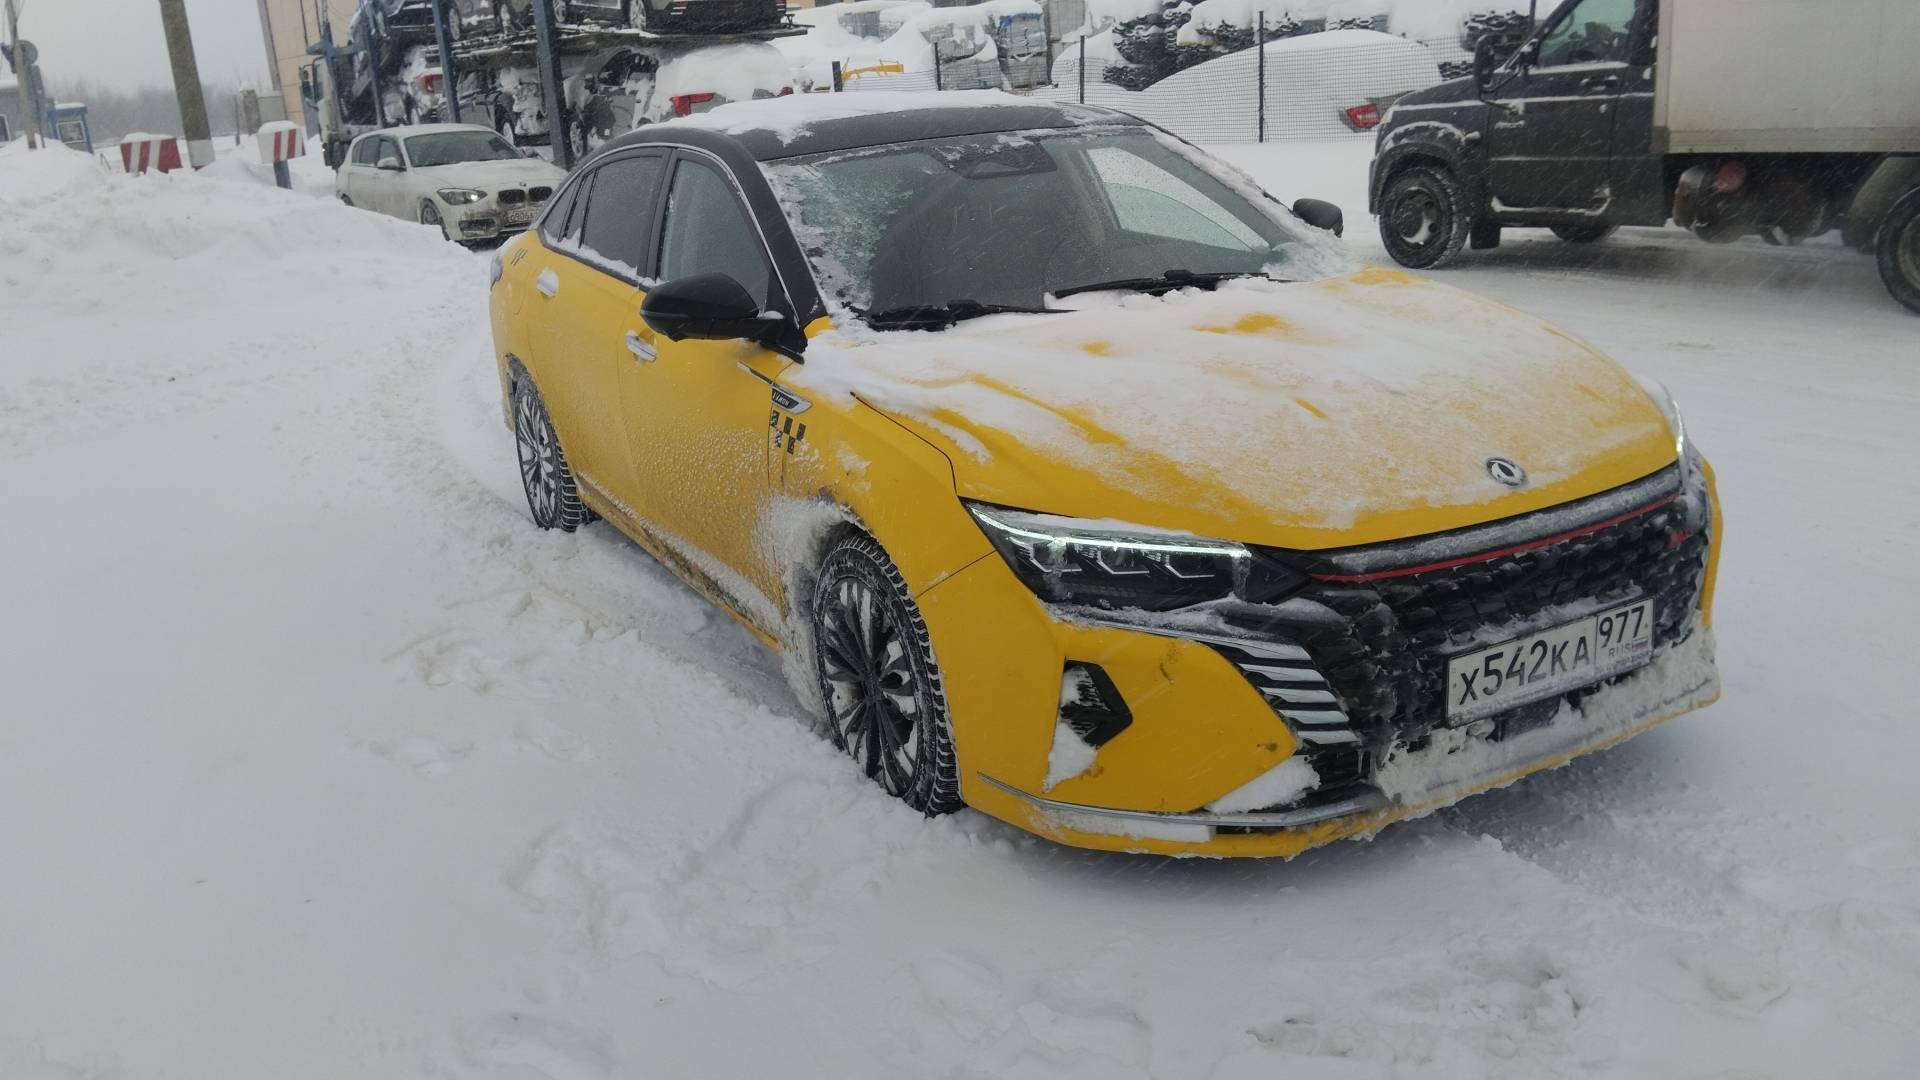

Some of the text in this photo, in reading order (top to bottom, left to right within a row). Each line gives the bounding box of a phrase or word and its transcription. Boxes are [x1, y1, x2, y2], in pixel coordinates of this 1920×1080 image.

[1459, 605, 1645, 705] Х542КА 977
[1608, 643, 1632, 657] RUS
